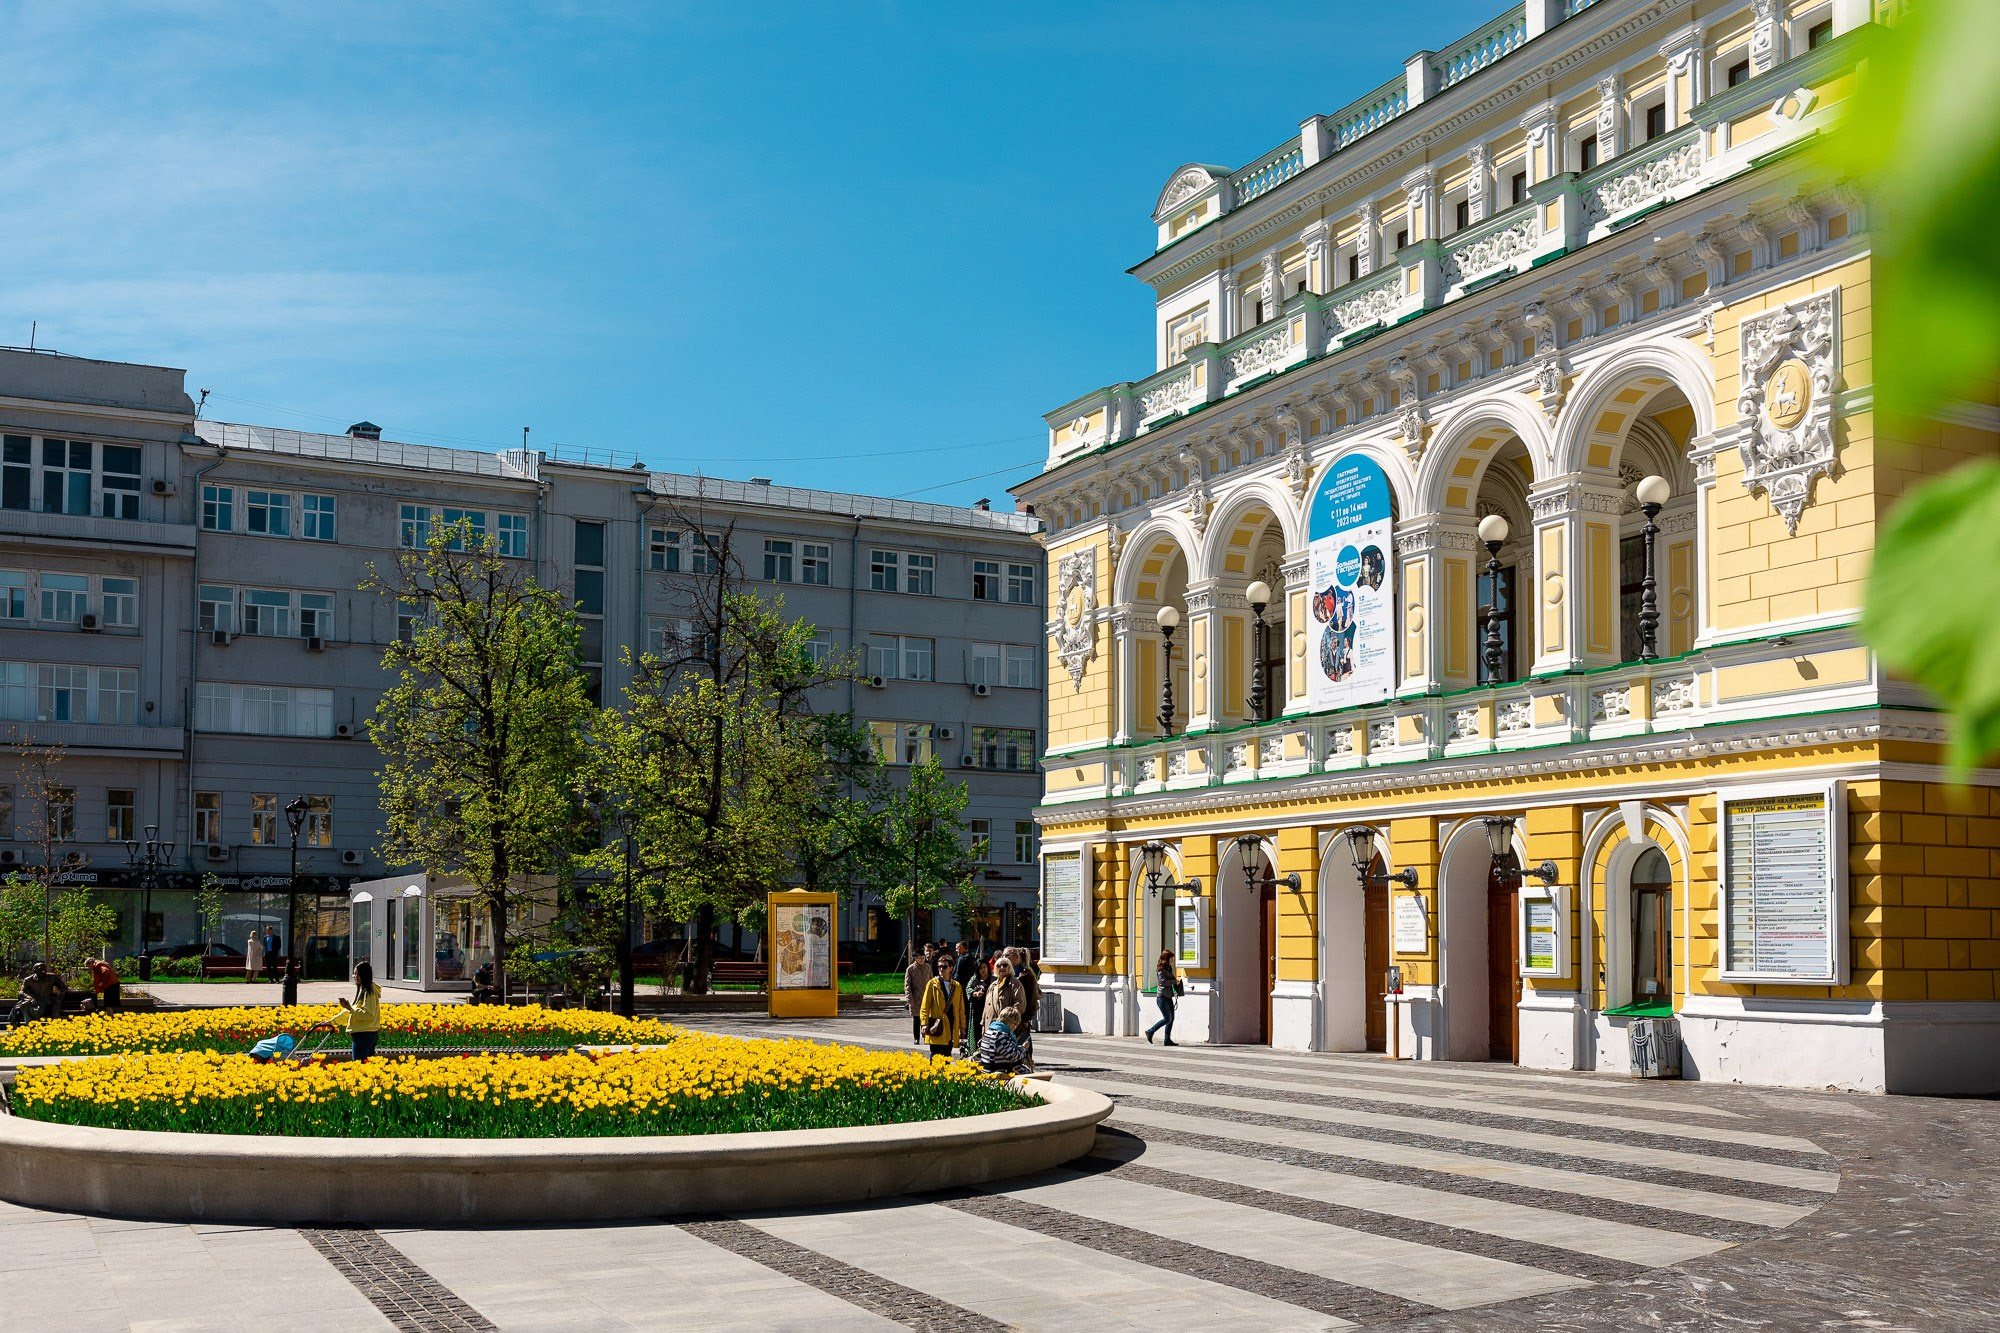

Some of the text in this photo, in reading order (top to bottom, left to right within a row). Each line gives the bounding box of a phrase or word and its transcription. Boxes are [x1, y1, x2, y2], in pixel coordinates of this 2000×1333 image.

[1337, 467, 1358, 478] ГАСТРОЛИ
[1336, 508, 1342, 517] 11
[1343, 507, 1349, 515] по
[1350, 503, 1356, 513] 14
[1357, 502, 1367, 510] мая
[1337, 514, 1362, 528] 2023 года
[1777, 795, 1824, 804] АКАДЕМИЧЕСКИ
